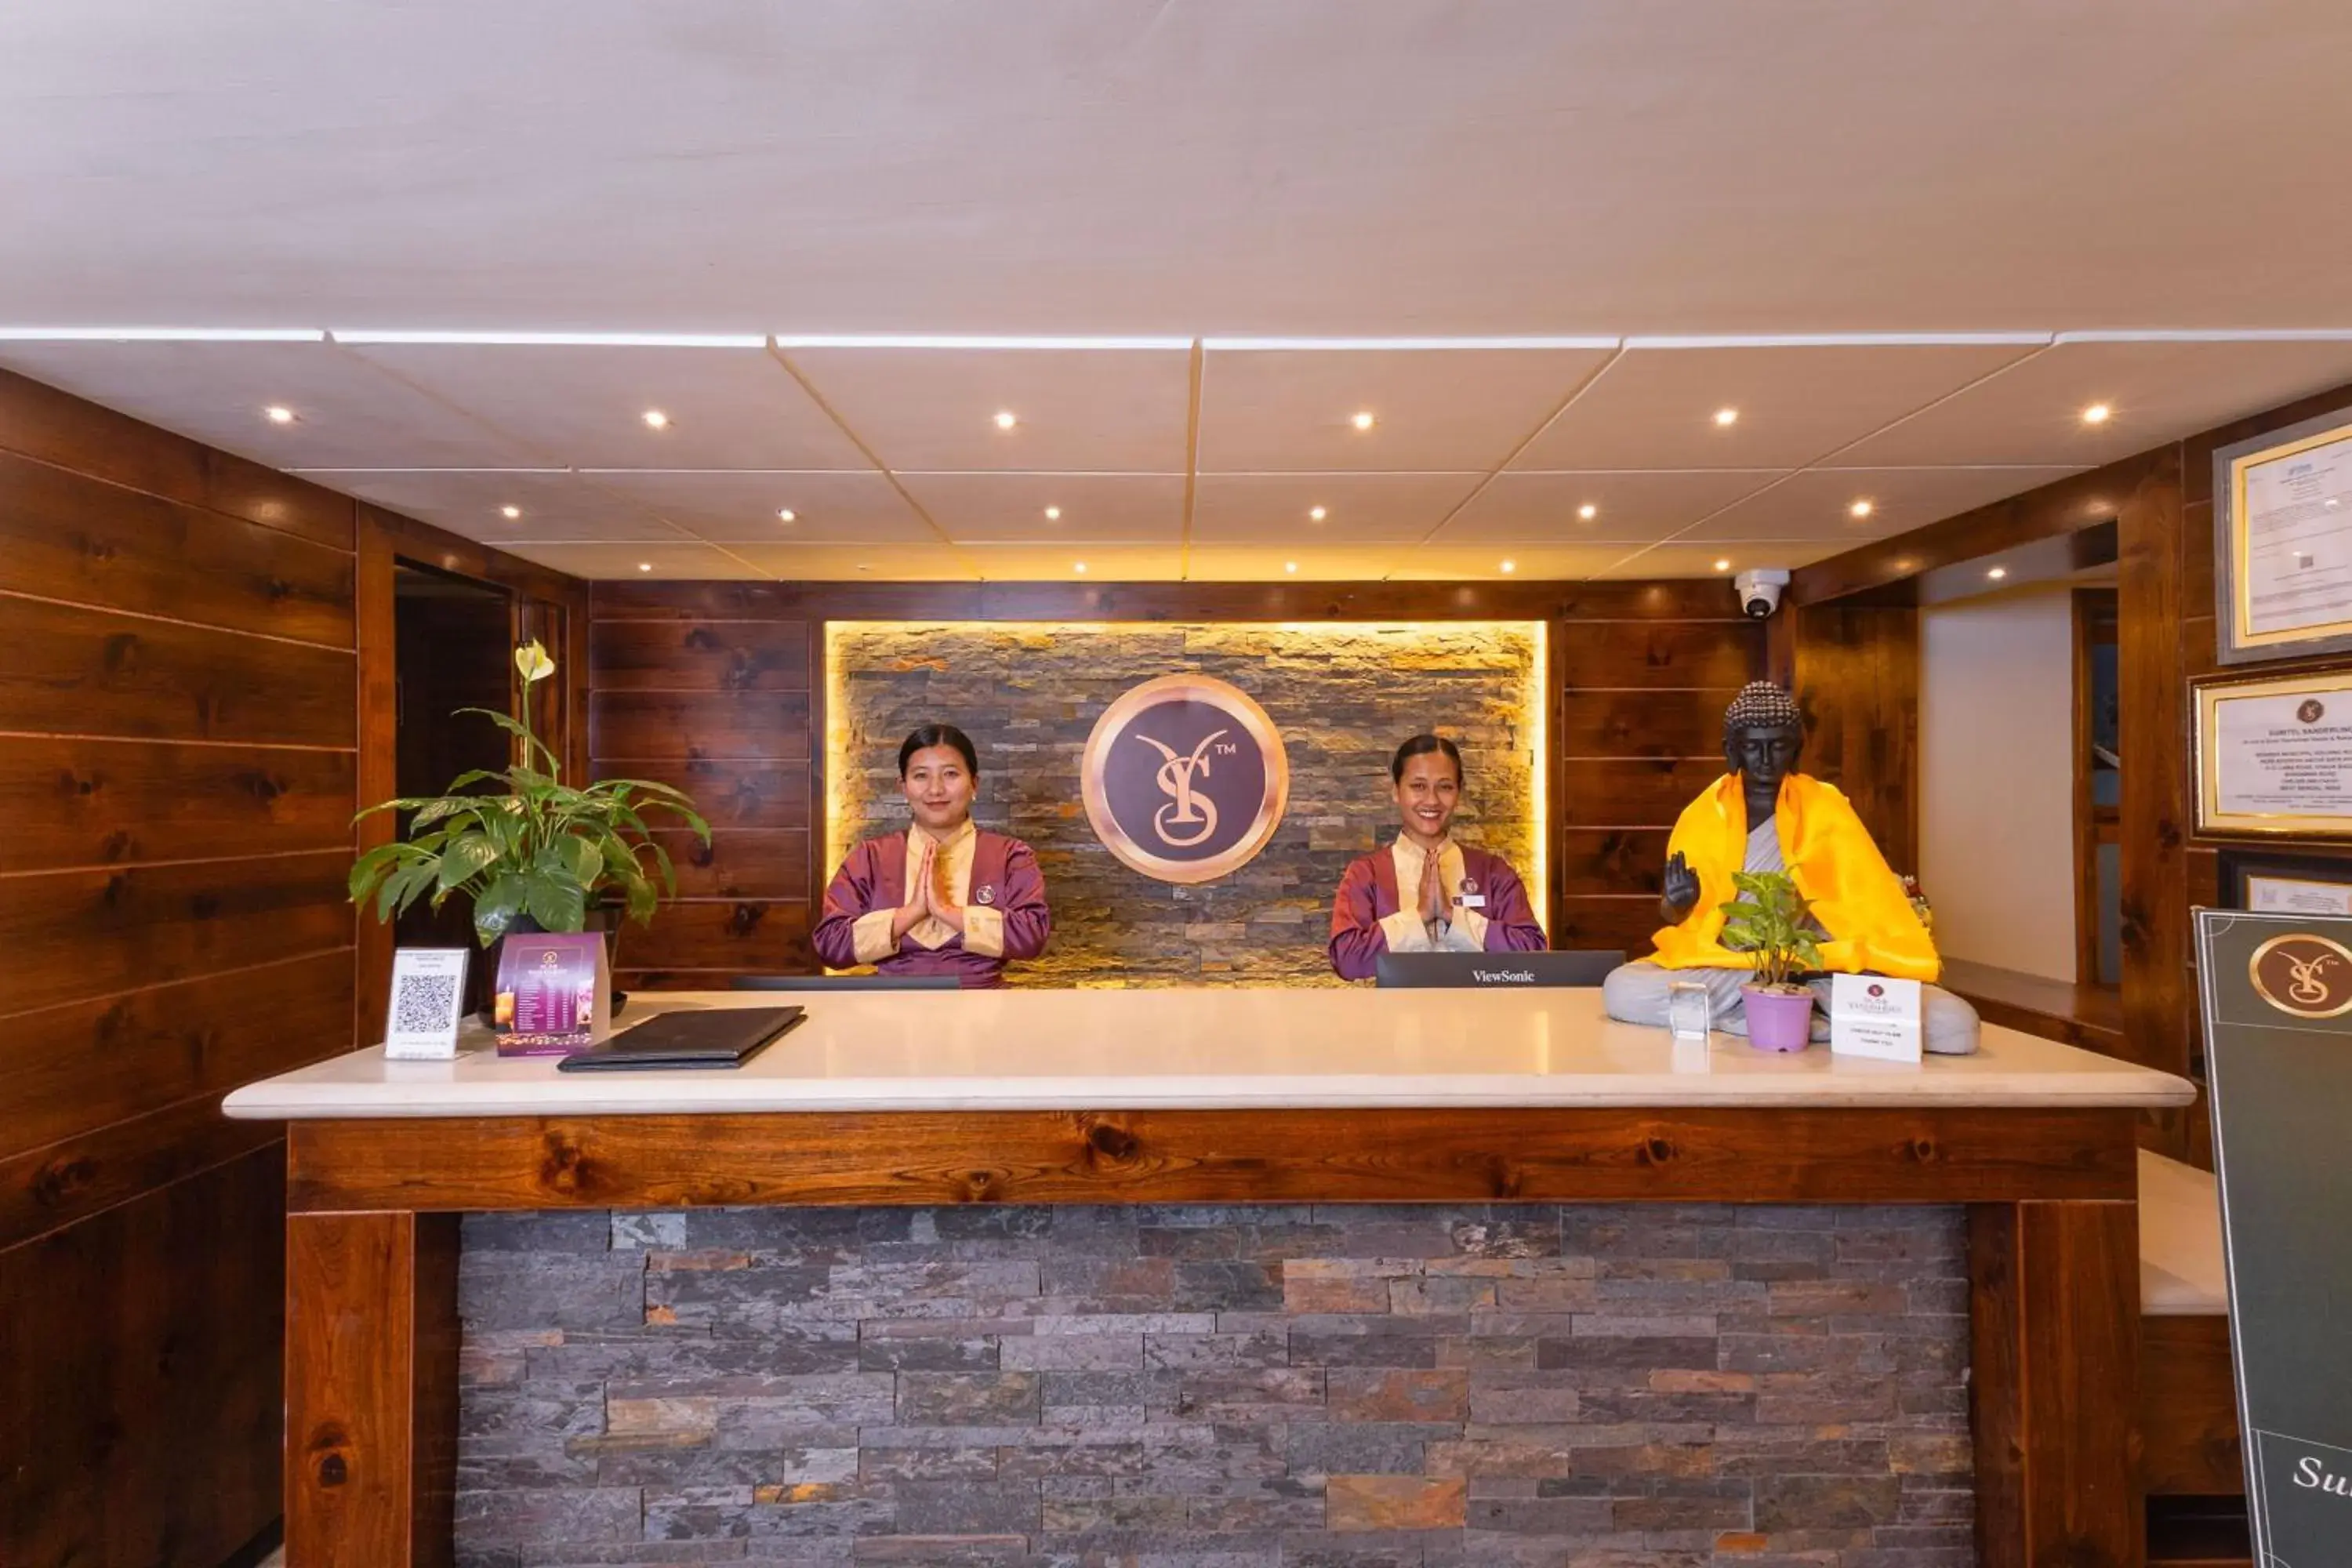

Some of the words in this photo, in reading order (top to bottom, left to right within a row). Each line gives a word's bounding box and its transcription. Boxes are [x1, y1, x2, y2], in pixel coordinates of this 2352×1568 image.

[1216, 743, 1236, 755] TM
[1472, 970, 1535, 982] ViewSonic
[2292, 1456, 2352, 1497] Su
